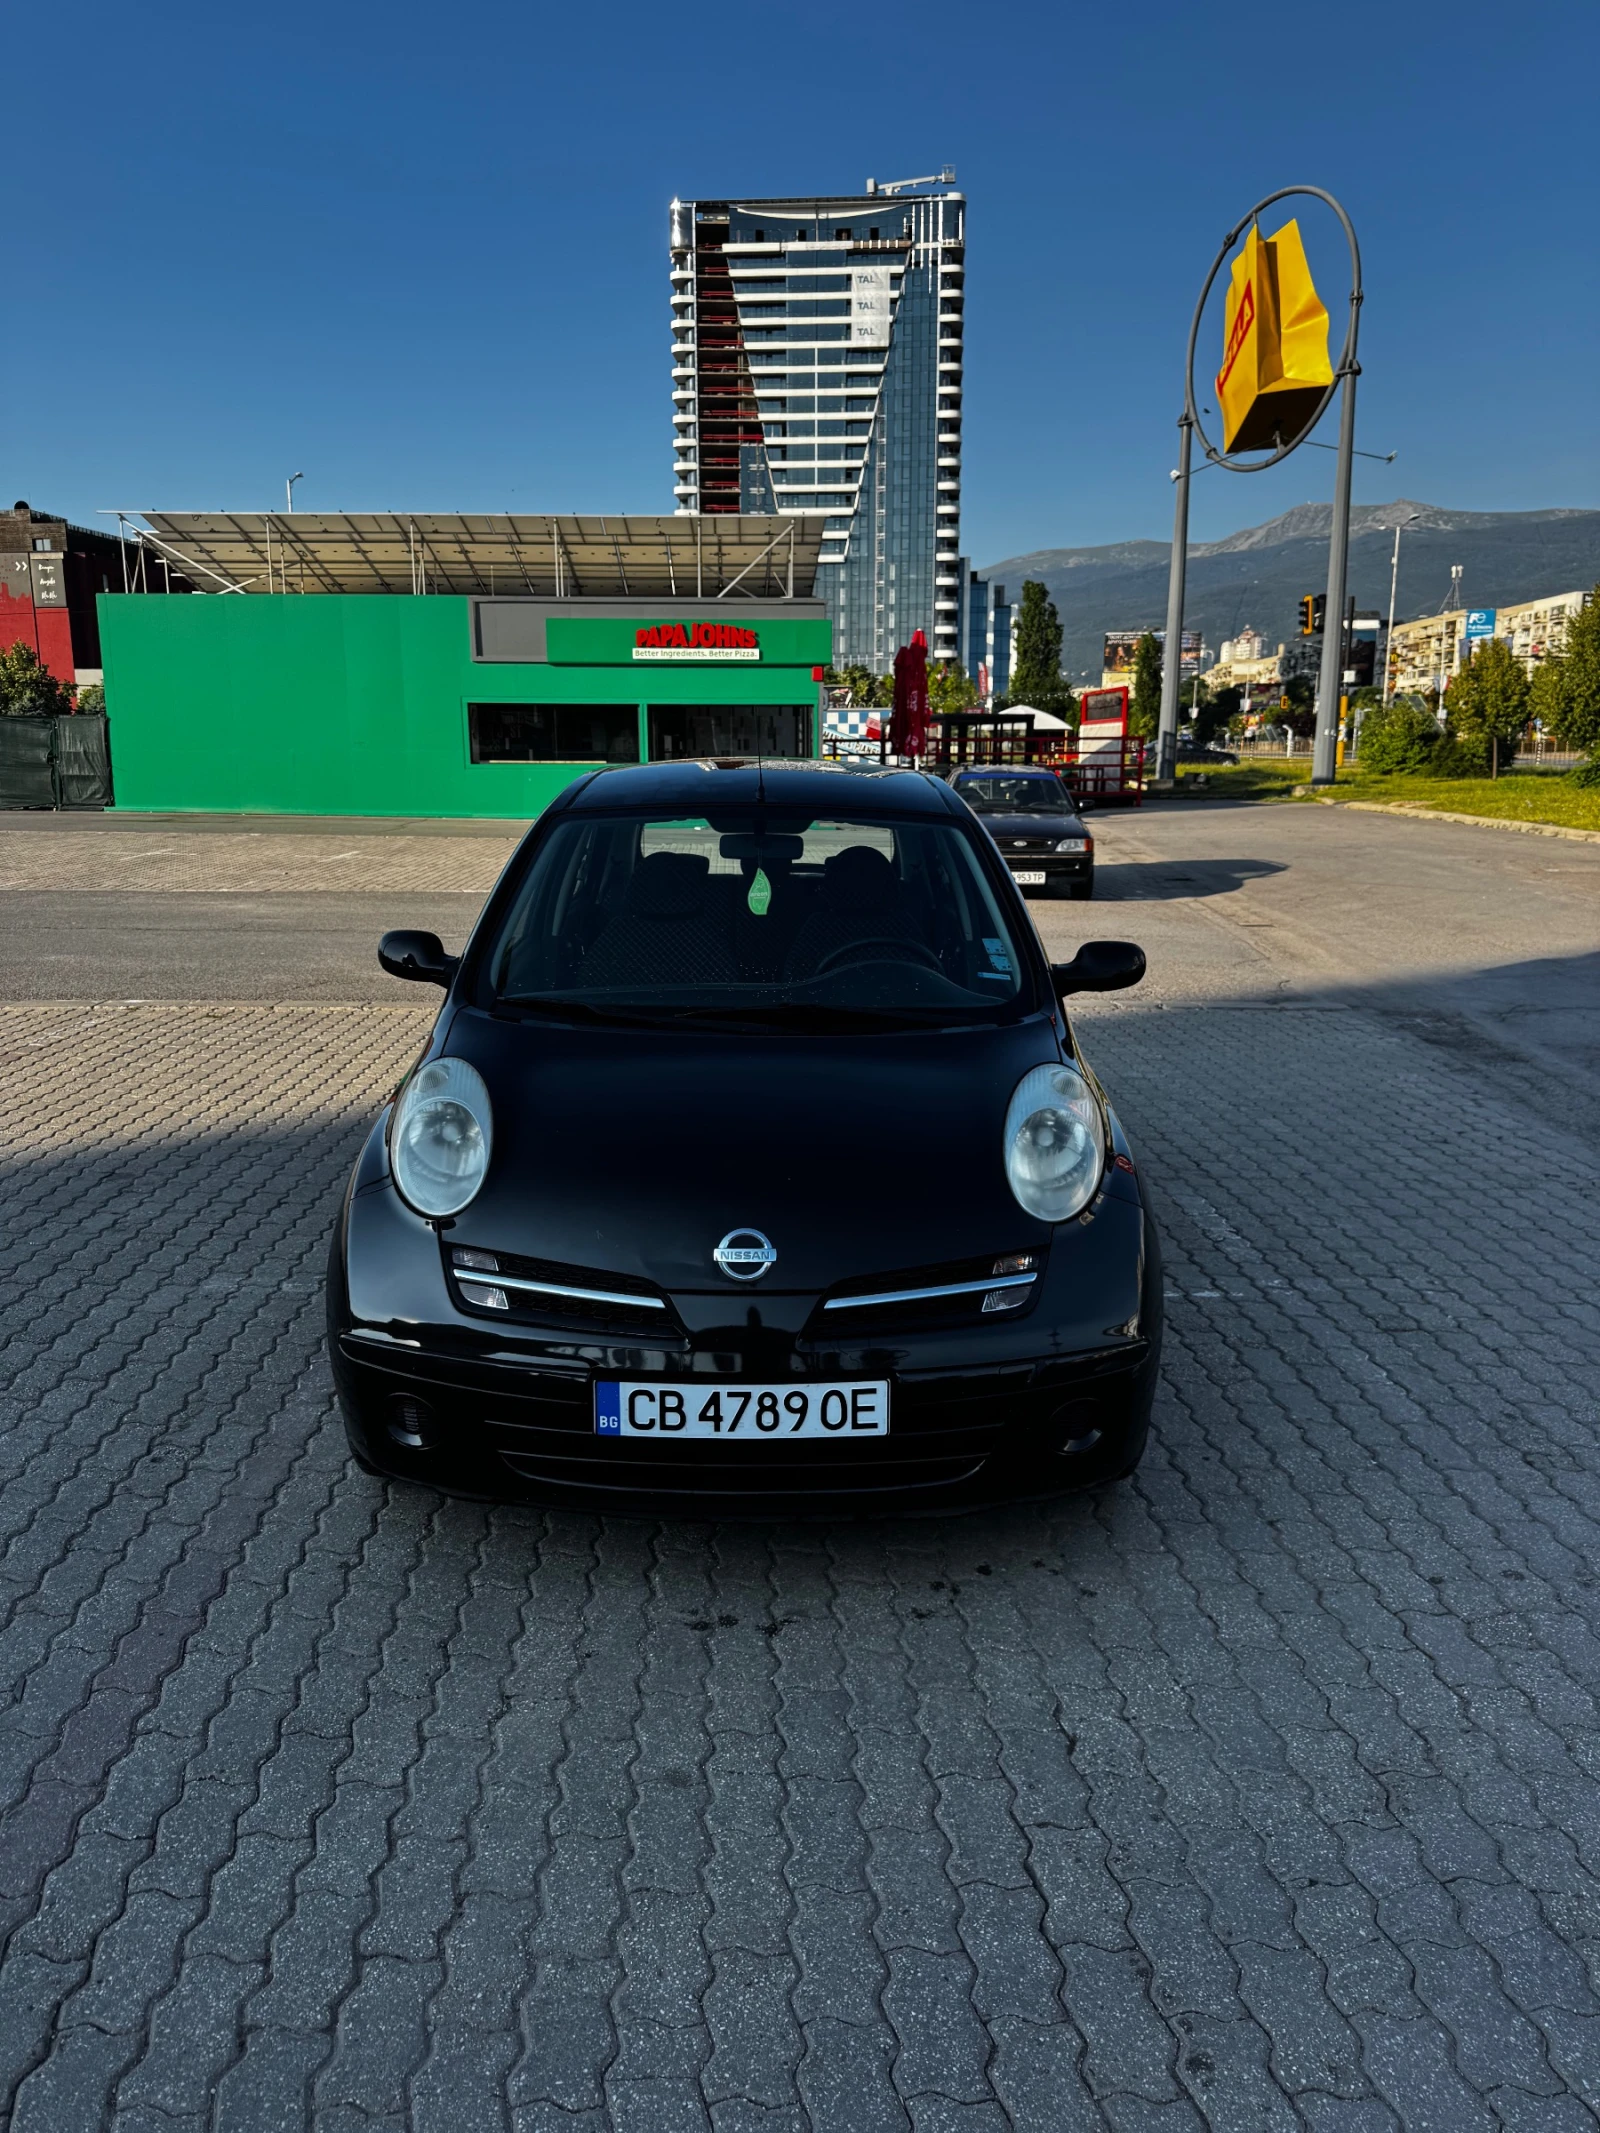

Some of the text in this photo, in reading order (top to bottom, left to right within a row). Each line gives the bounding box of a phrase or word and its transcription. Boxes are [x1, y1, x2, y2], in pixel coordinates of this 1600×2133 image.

[857, 275, 875, 284] TAL
[857, 301, 875, 310] TAL
[857, 327, 875, 336] TAL
[636, 621, 757, 648] PAPA JOHNS
[660, 650, 707, 658] Ingredients.
[1013, 873, 1044, 882] 953 TP
[720, 1251, 770, 1260] NISSAN
[599, 1387, 879, 1432] BG CB 4789 OE
